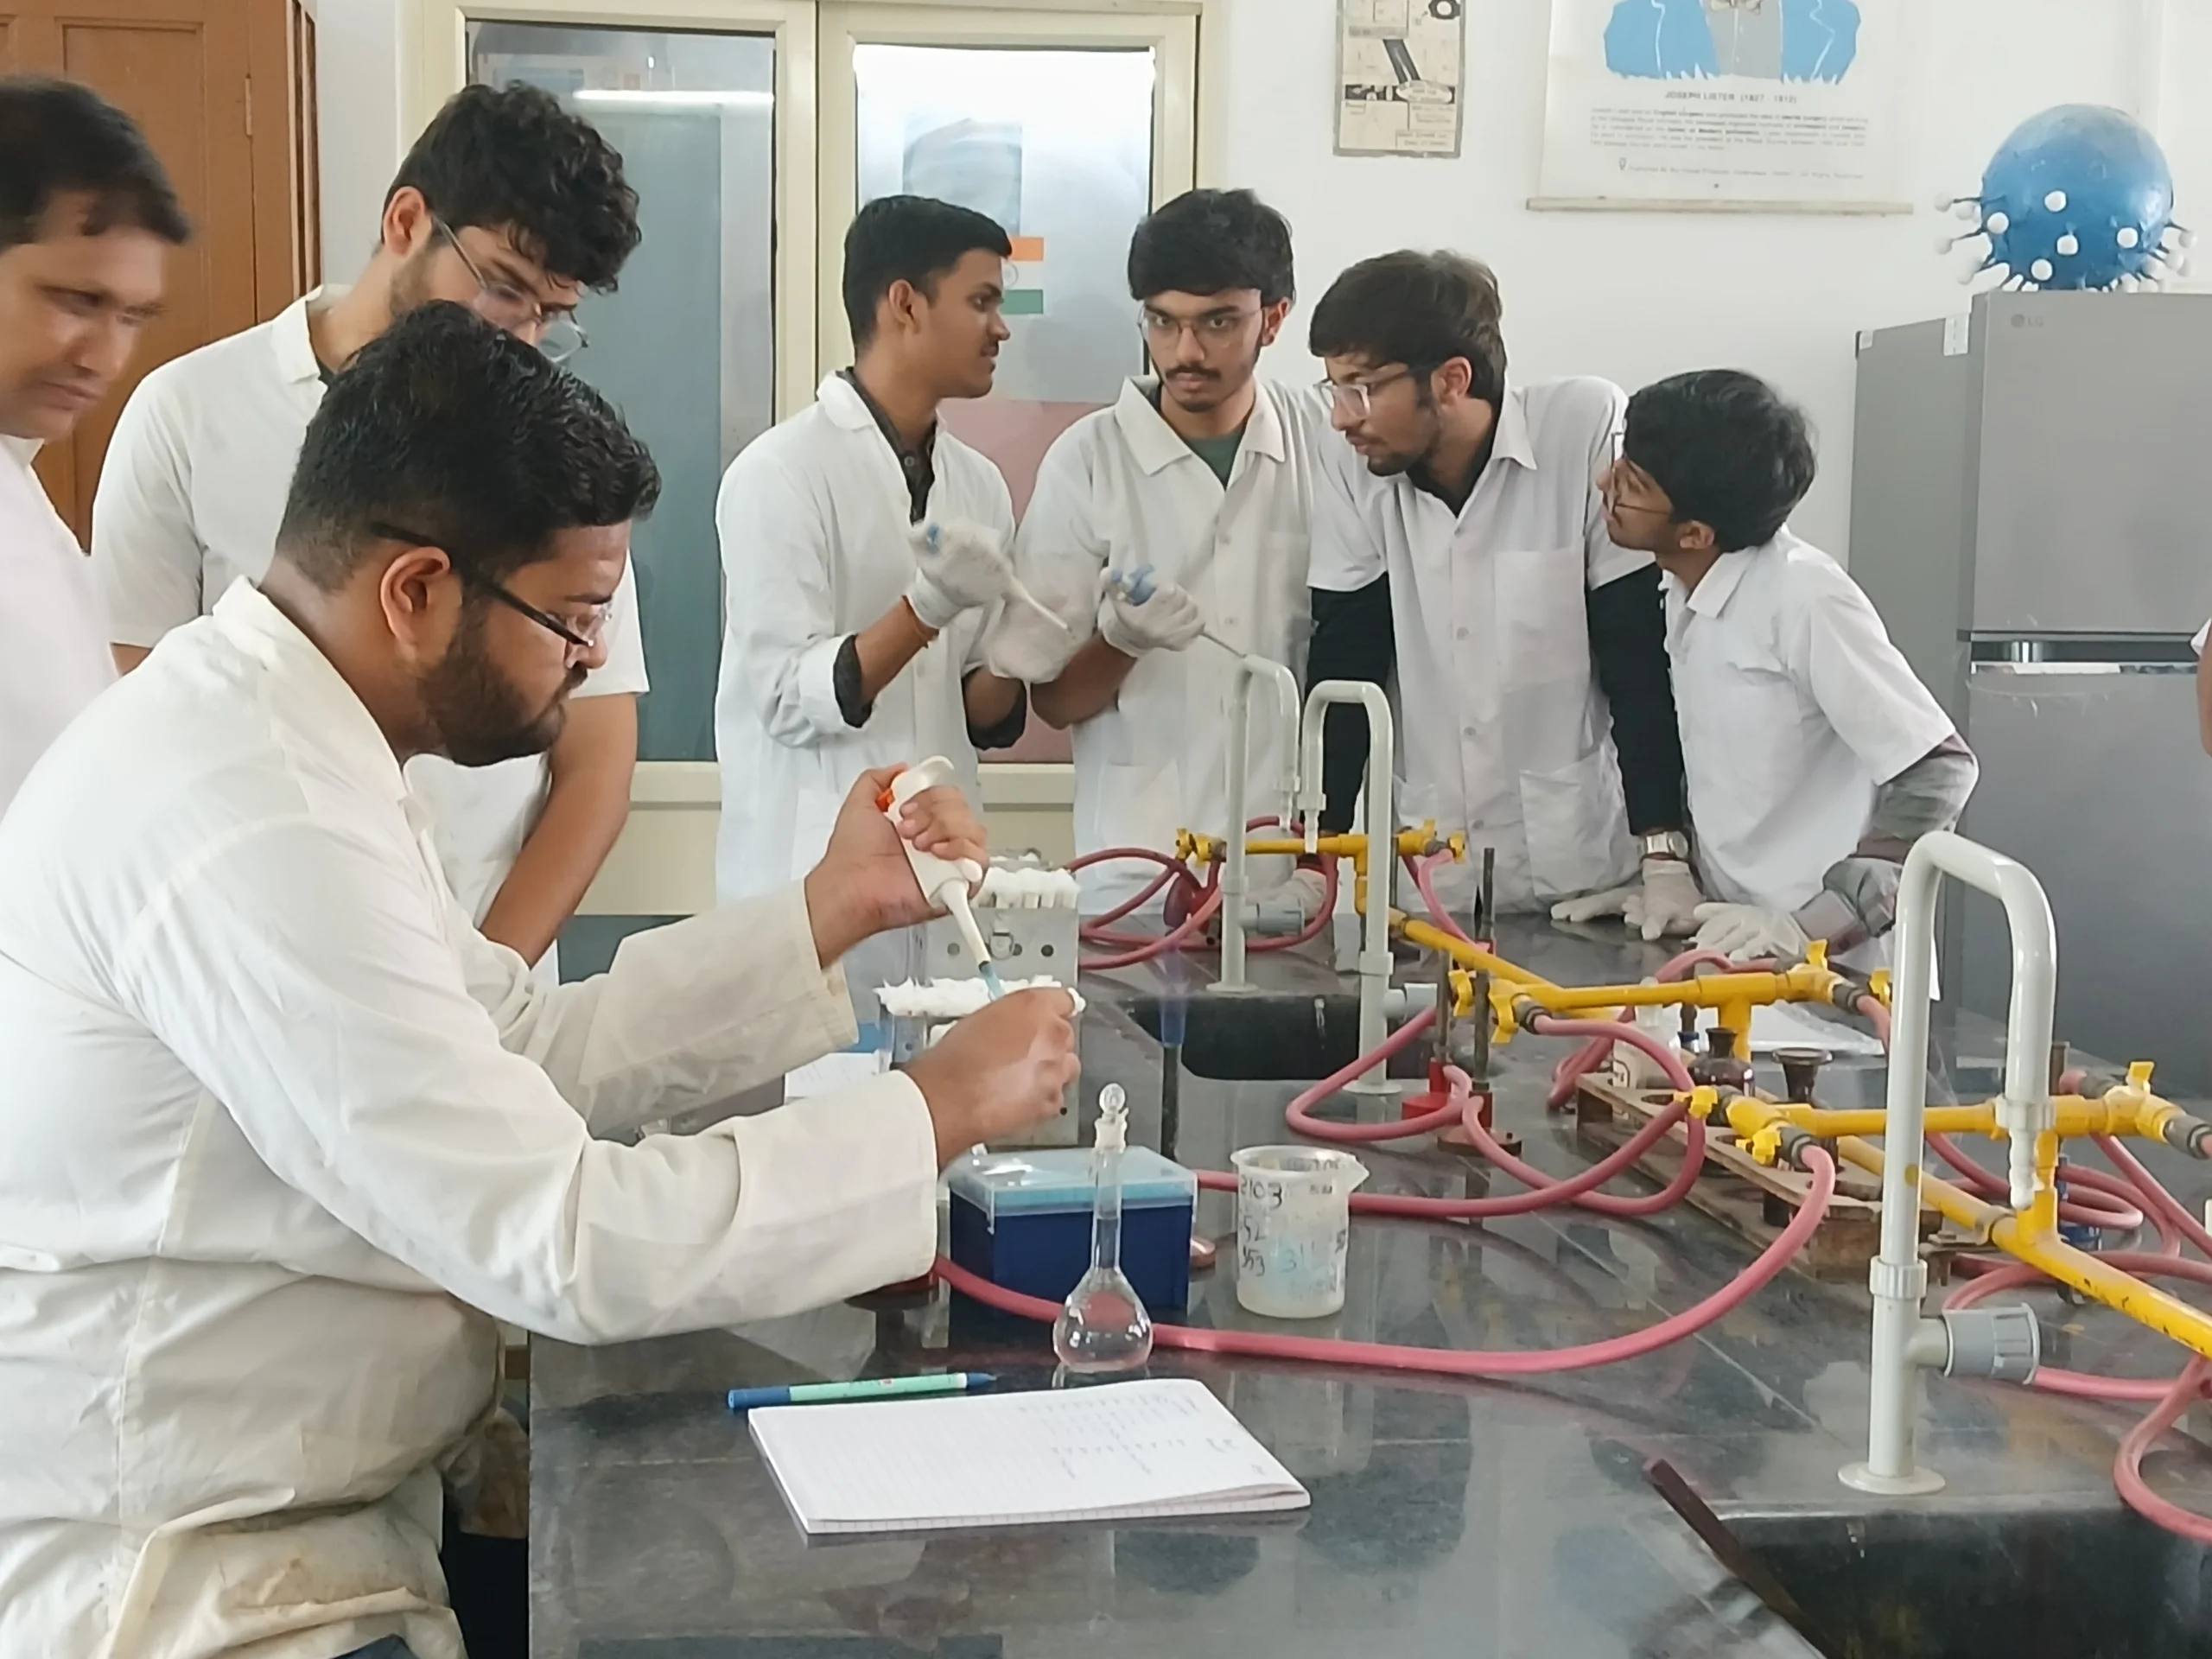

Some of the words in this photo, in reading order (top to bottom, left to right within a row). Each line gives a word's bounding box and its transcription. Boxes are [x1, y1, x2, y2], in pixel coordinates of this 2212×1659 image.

[1665, 91, 1701, 99] JOSEPH
[1703, 92, 1735, 101] LISTER
[2028, 316, 2044, 327] LG
